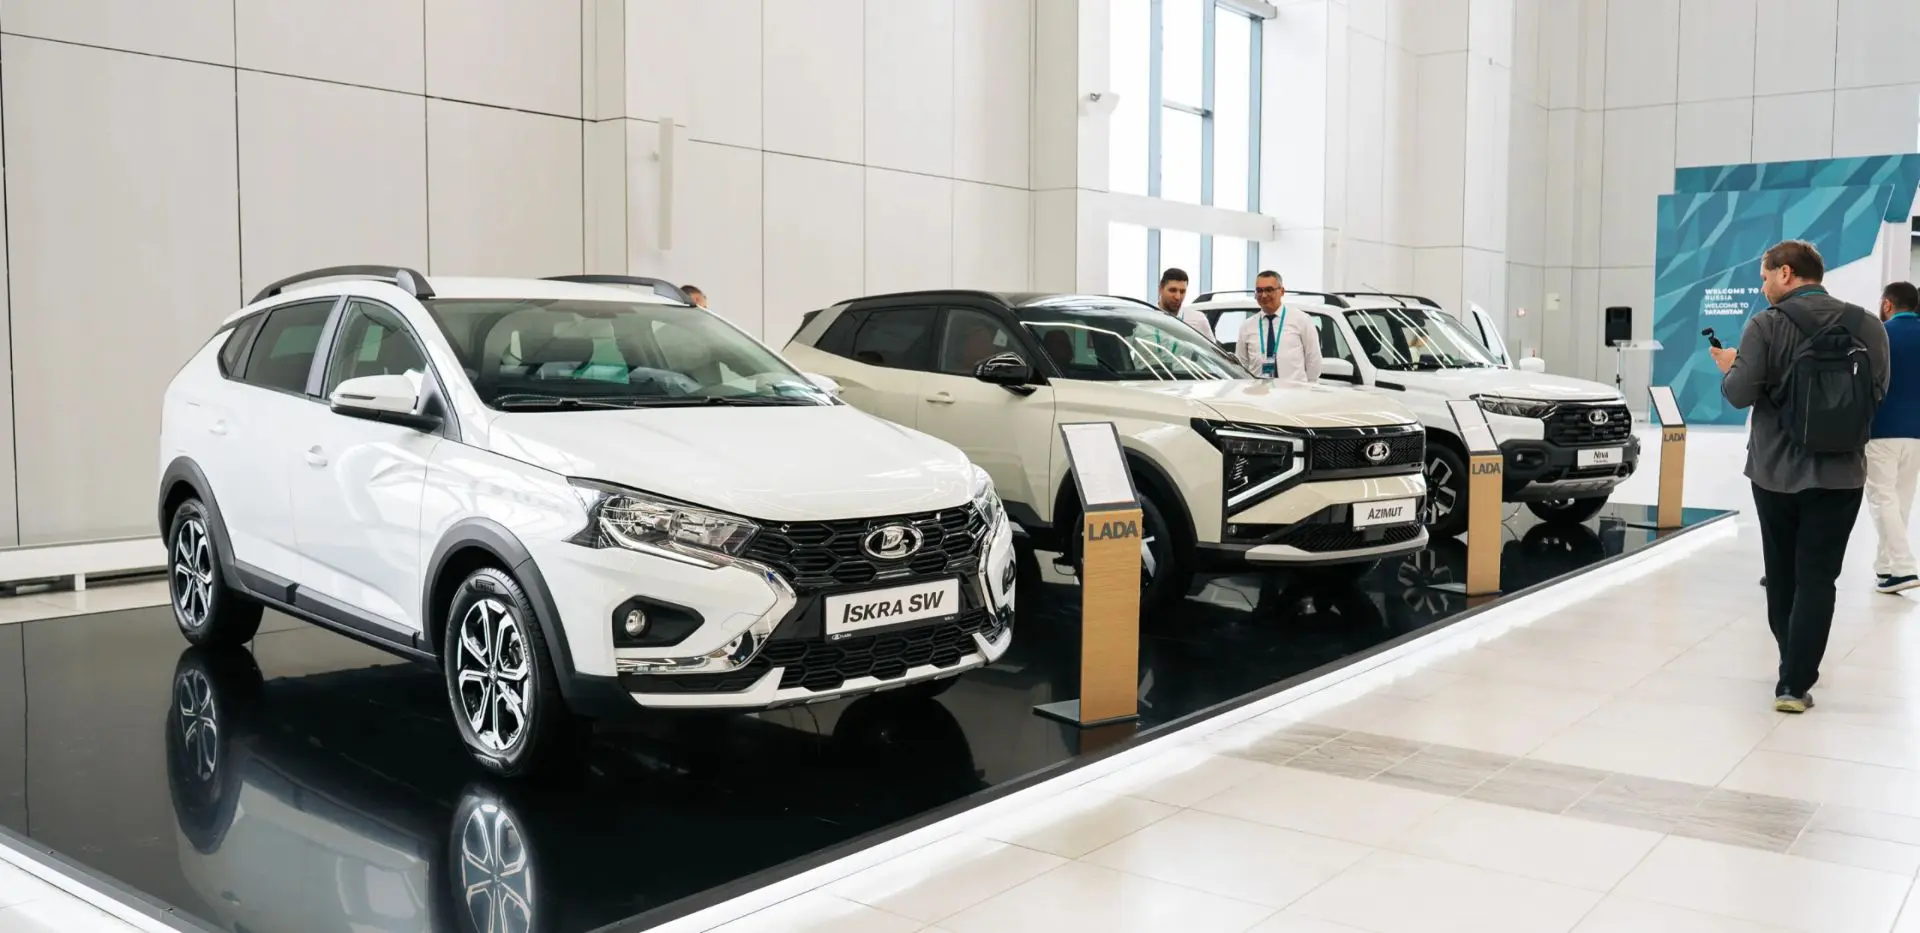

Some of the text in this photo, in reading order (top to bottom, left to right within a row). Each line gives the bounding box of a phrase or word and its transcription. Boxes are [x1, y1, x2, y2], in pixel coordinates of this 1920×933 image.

[1664, 433, 1685, 442] LADA
[1472, 462, 1501, 475] LADA
[1367, 506, 1403, 520] AZIMUT
[1088, 520, 1139, 541] LADA
[842, 590, 945, 624] ISKRA SW
